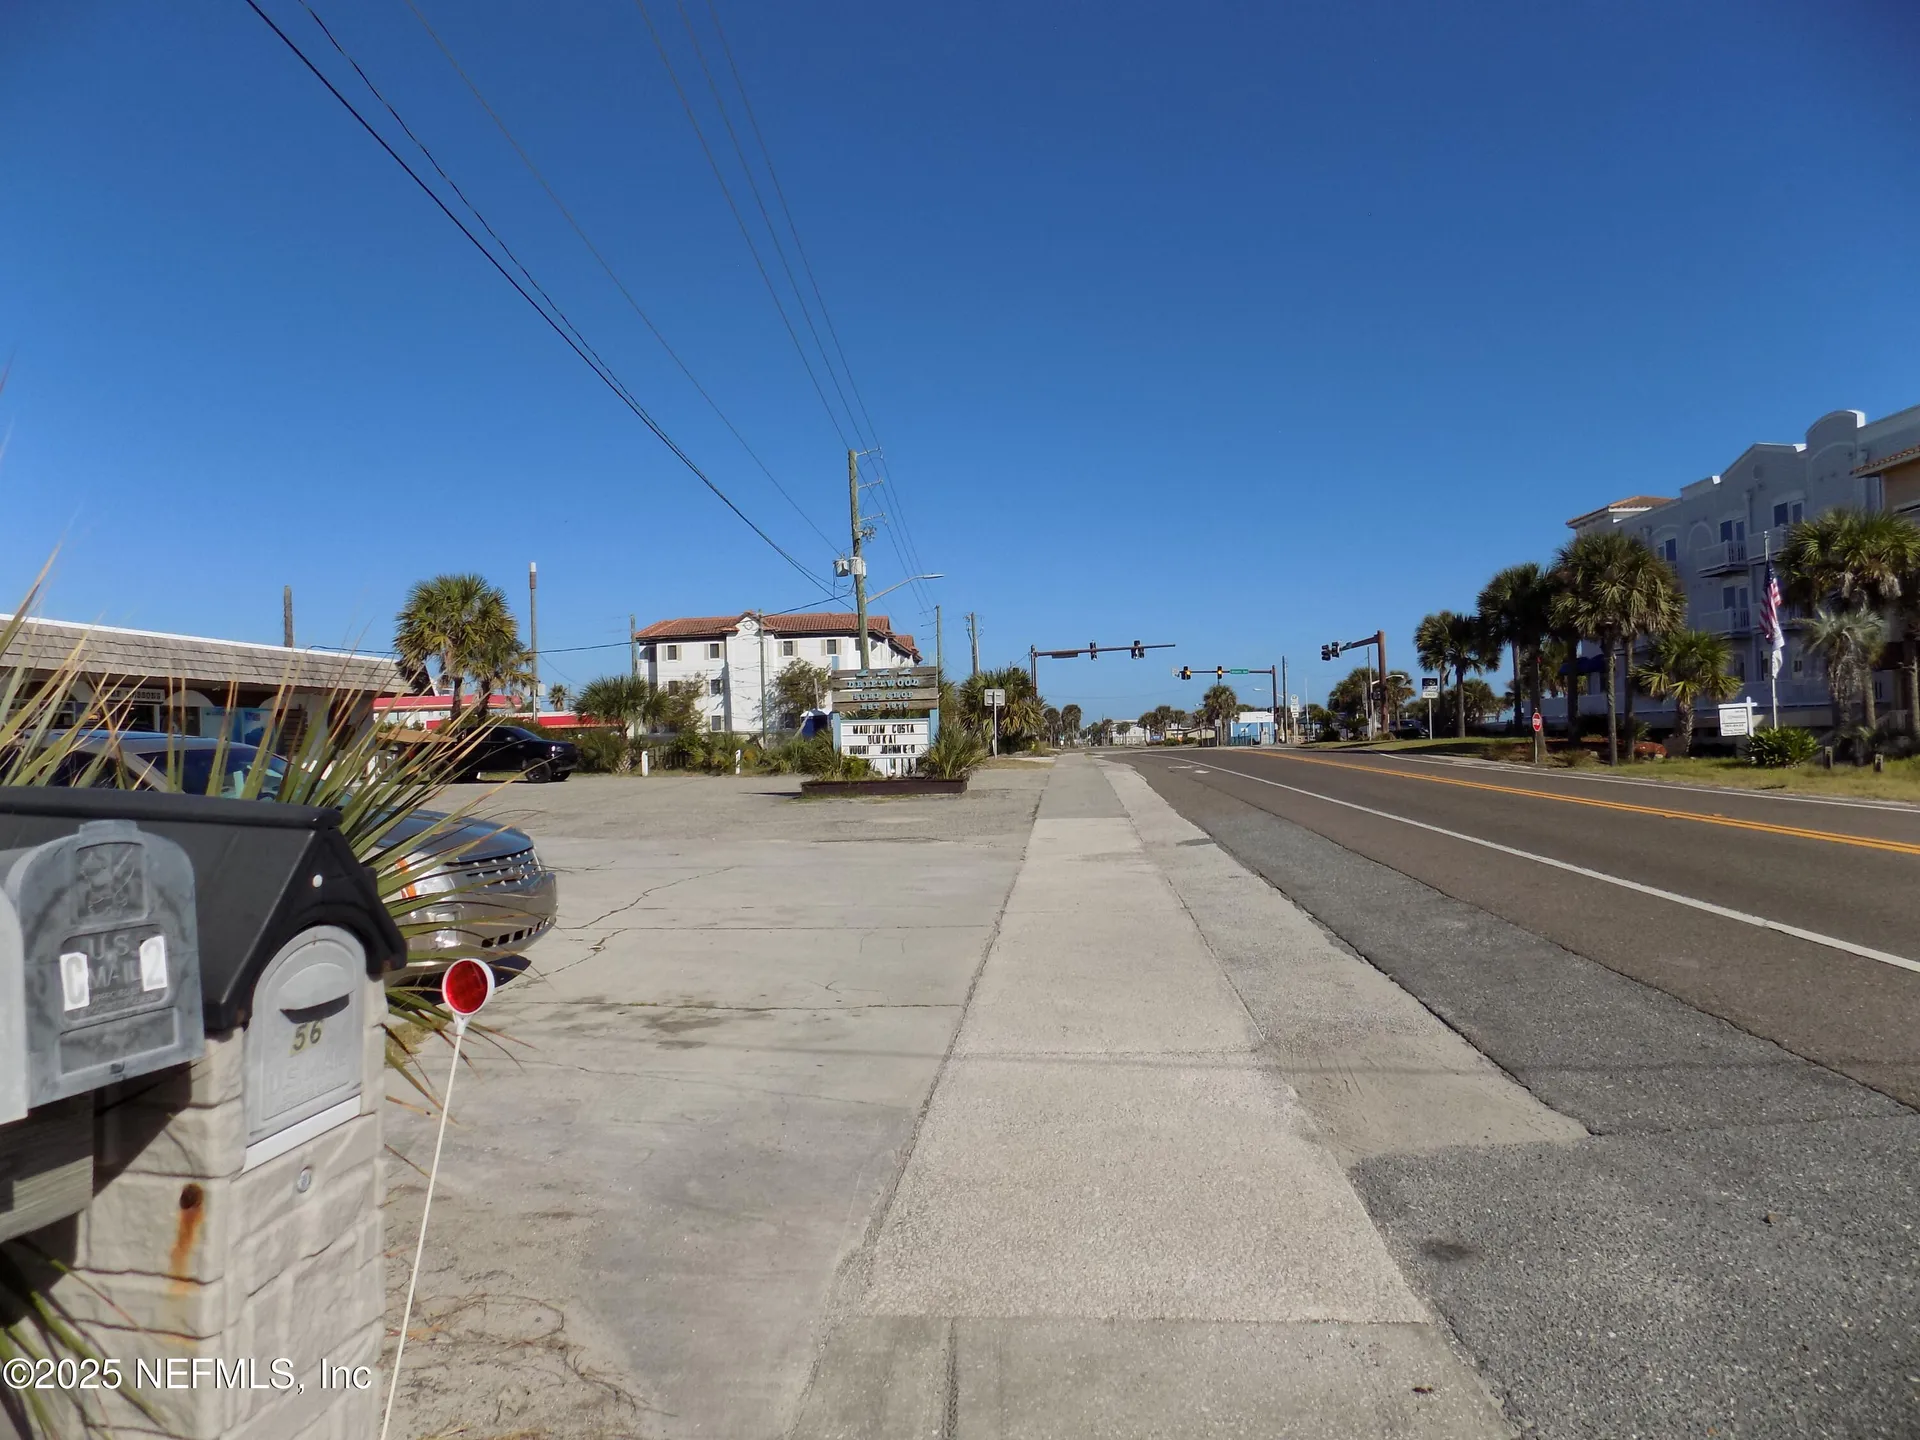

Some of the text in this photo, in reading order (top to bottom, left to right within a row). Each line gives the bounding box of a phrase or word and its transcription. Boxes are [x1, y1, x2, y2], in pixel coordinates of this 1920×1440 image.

[847, 679, 919, 689] DRIFTWOOD
[886, 691, 913, 699] SHOP
[892, 723, 914, 734] COSTA
[867, 735, 896, 744] OLUKAI
[849, 745, 869, 755] VUORI
[143, 938, 164, 986] 2
[293, 1019, 323, 1051] 56
